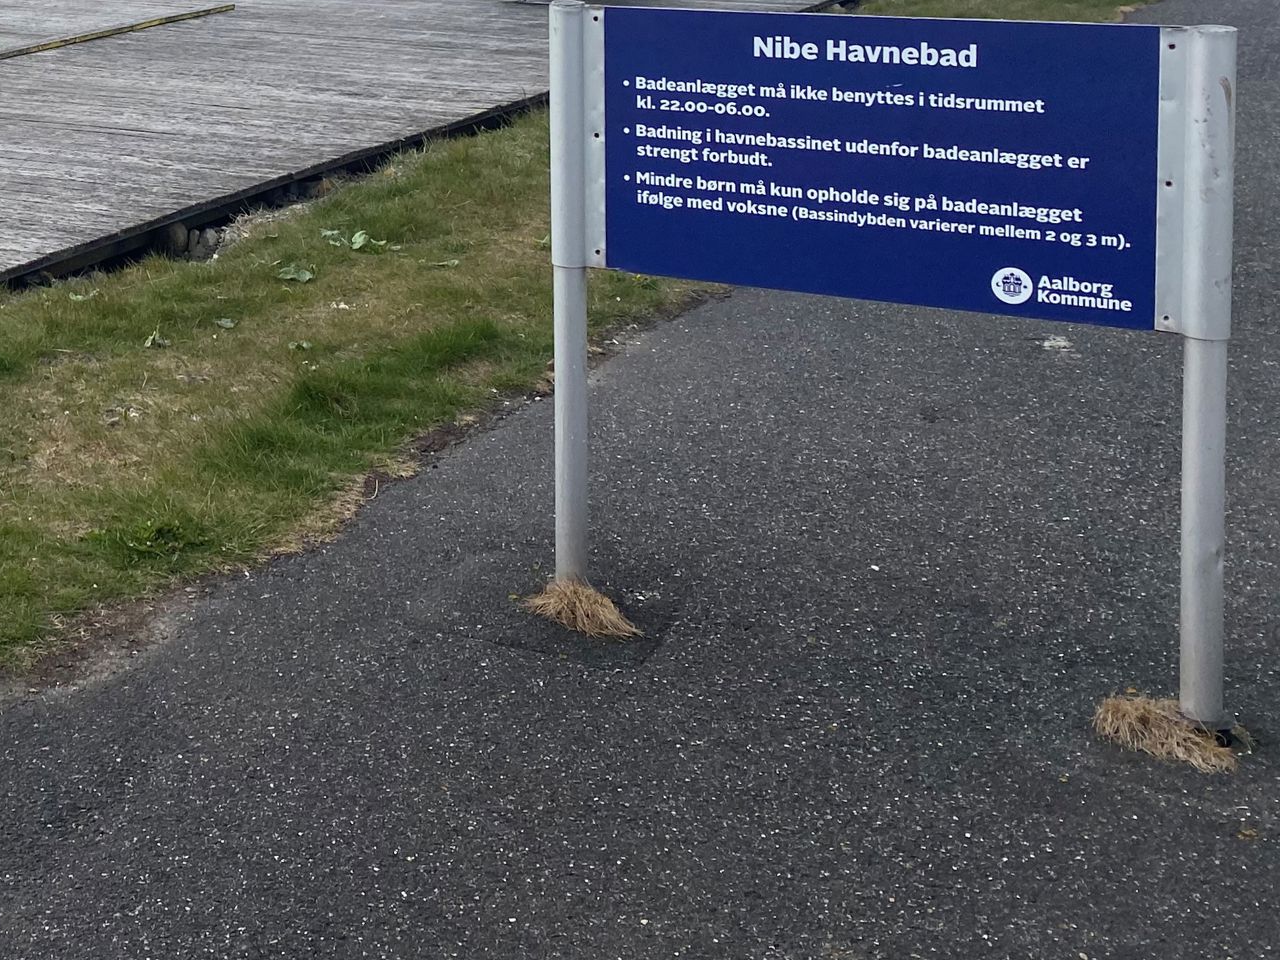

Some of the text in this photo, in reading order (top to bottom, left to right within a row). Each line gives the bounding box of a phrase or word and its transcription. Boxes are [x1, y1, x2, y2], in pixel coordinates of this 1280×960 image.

[754, 36, 977, 67] Nibe Havnebad
[636, 77, 1045, 113] Badeanlægget må ikke benyttes i tidsrummet
[637, 95, 770, 118] kl. 22.00-06.00.
[636, 124, 1090, 169] Badning i havnebassinet udenfor badeanlægget er
[637, 145, 773, 167] strengt forbudt.
[636, 172, 1082, 223] Mindre børn må kun opholde sig på badeanlægget
[637, 190, 1131, 250] ifølge med voksne (Bassindybden varierer mellem 2 og 3 m).
[1037, 275, 1113, 298] Aalborg
[1037, 289, 1132, 312] Kommune
